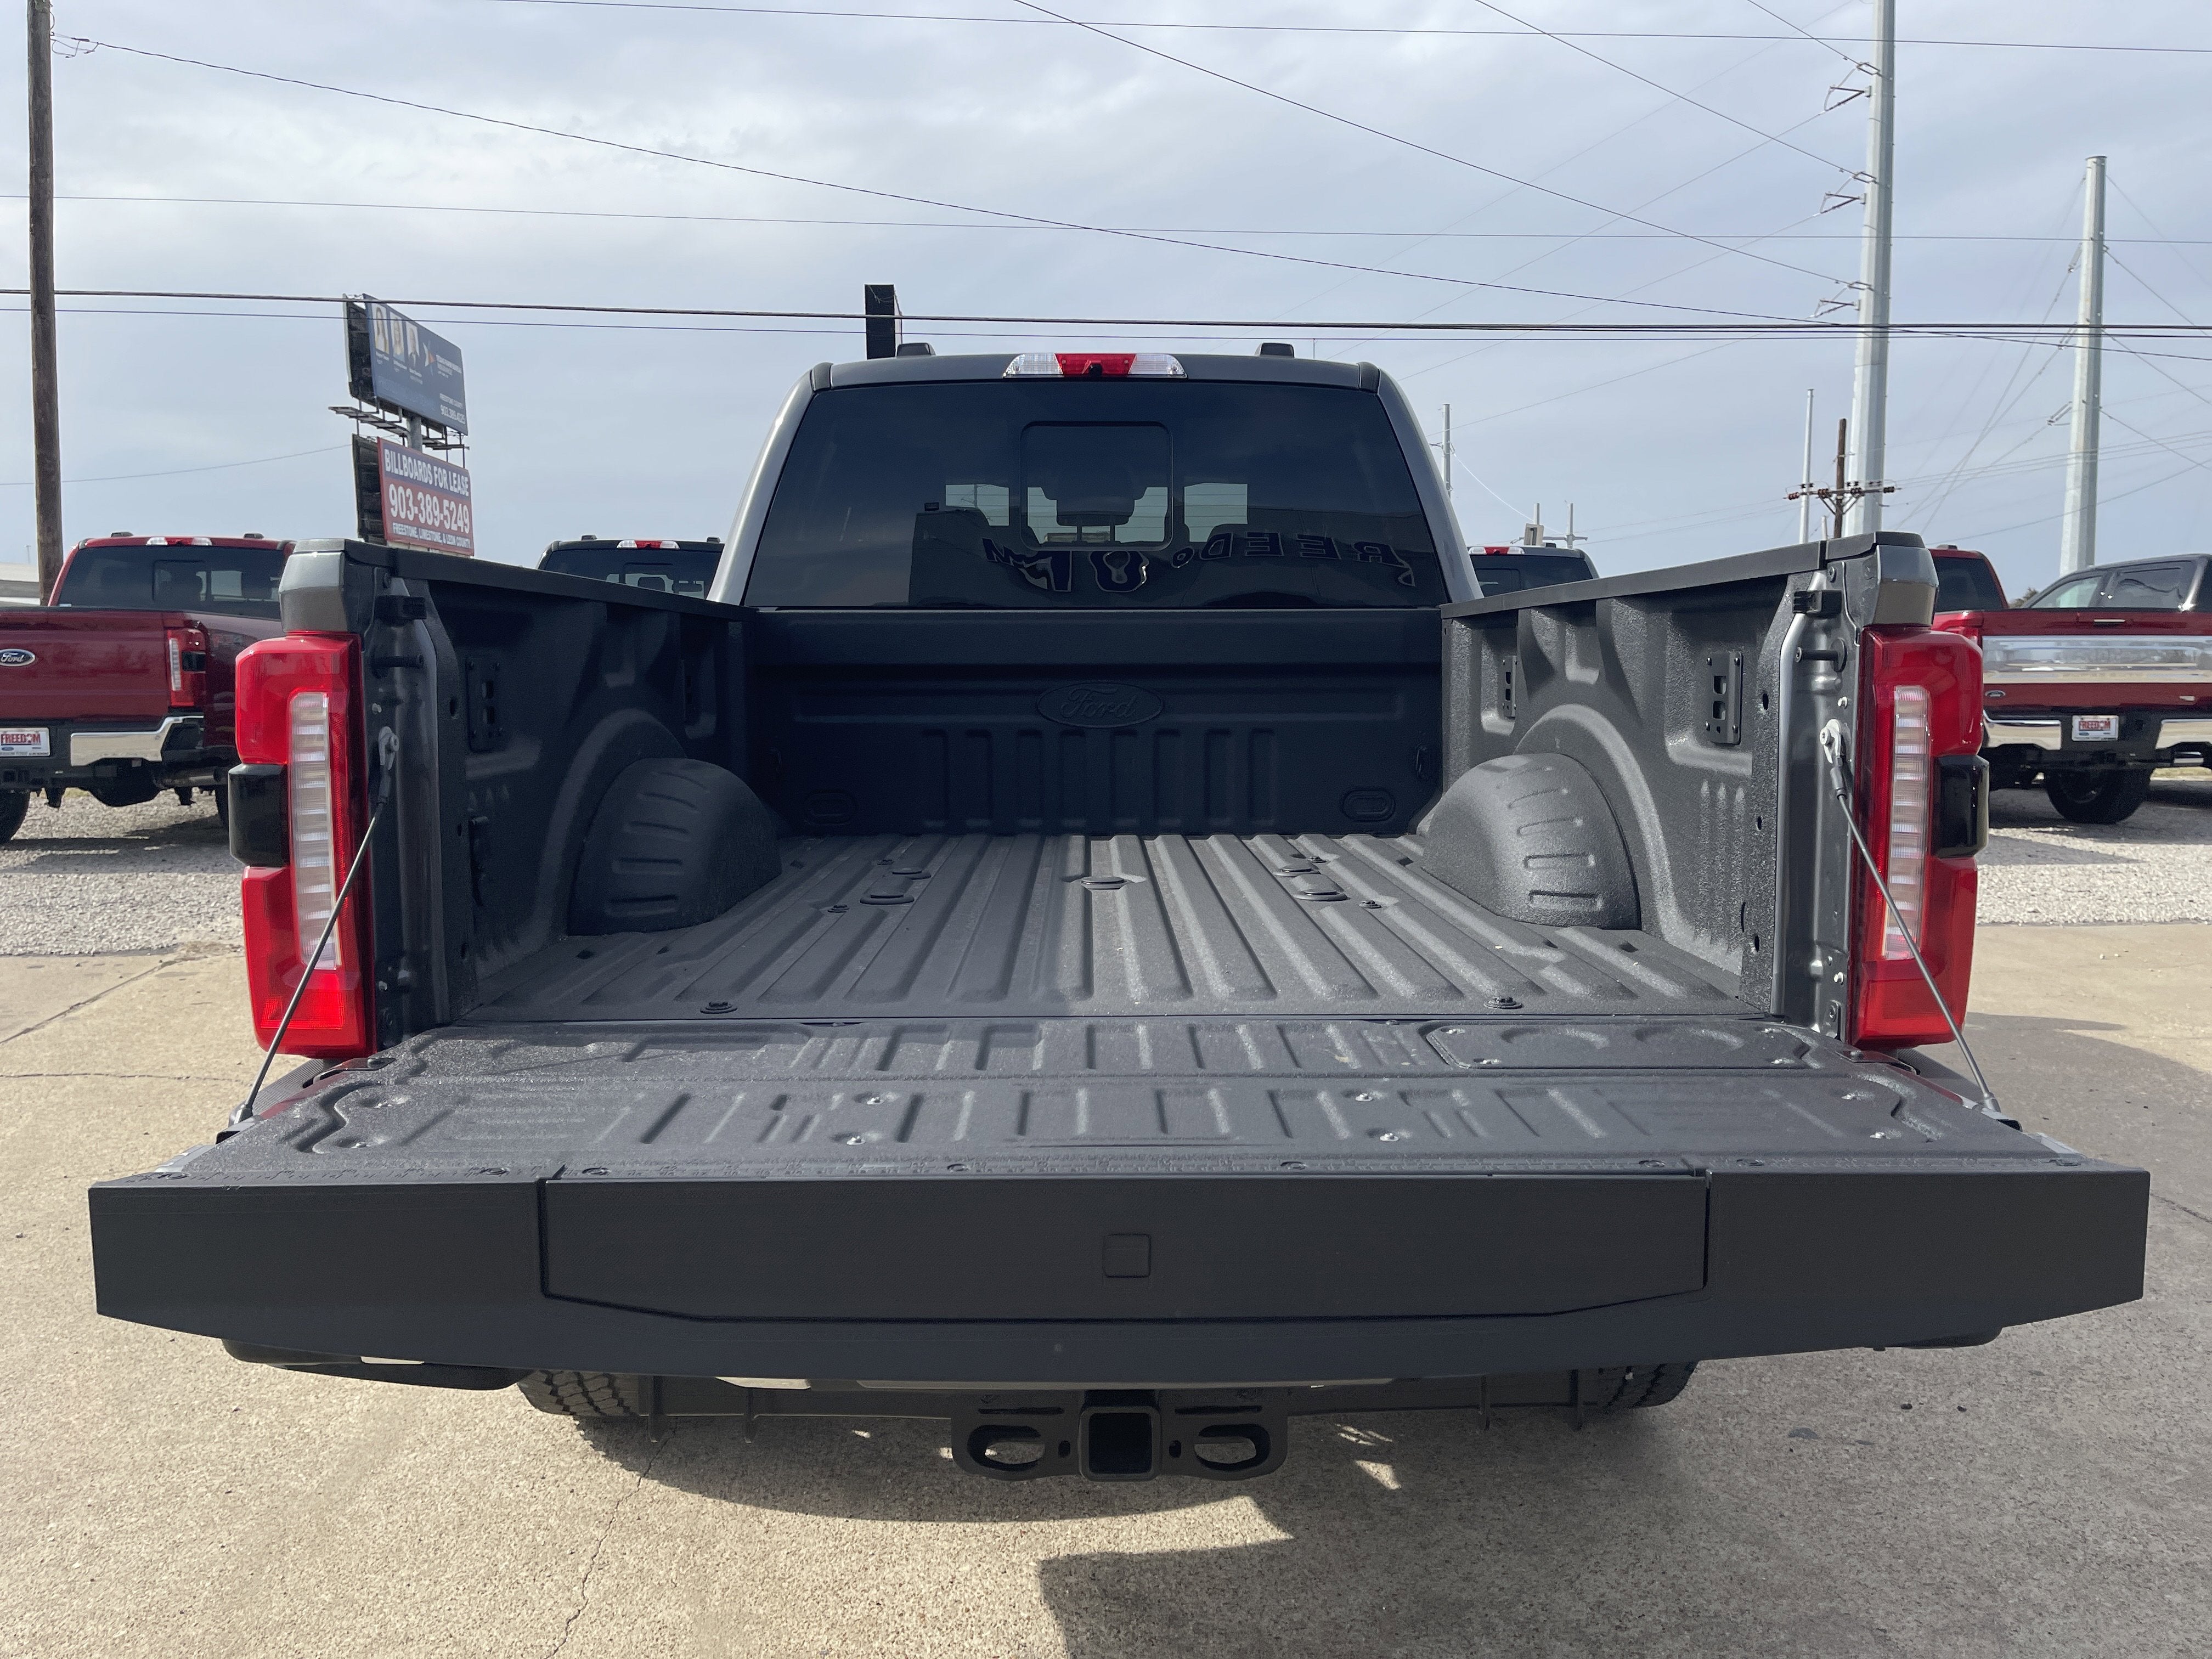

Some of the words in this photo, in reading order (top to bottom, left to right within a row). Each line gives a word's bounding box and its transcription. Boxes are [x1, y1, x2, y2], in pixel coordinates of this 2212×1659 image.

[384, 449, 433, 485] BILLBOARDS
[433, 466, 449, 490] FOR
[449, 471, 469, 496] LEASE
[389, 483, 470, 534] 903-389-5249
[1, 652, 25, 662] Ford
[1060, 689, 1138, 719] Ford
